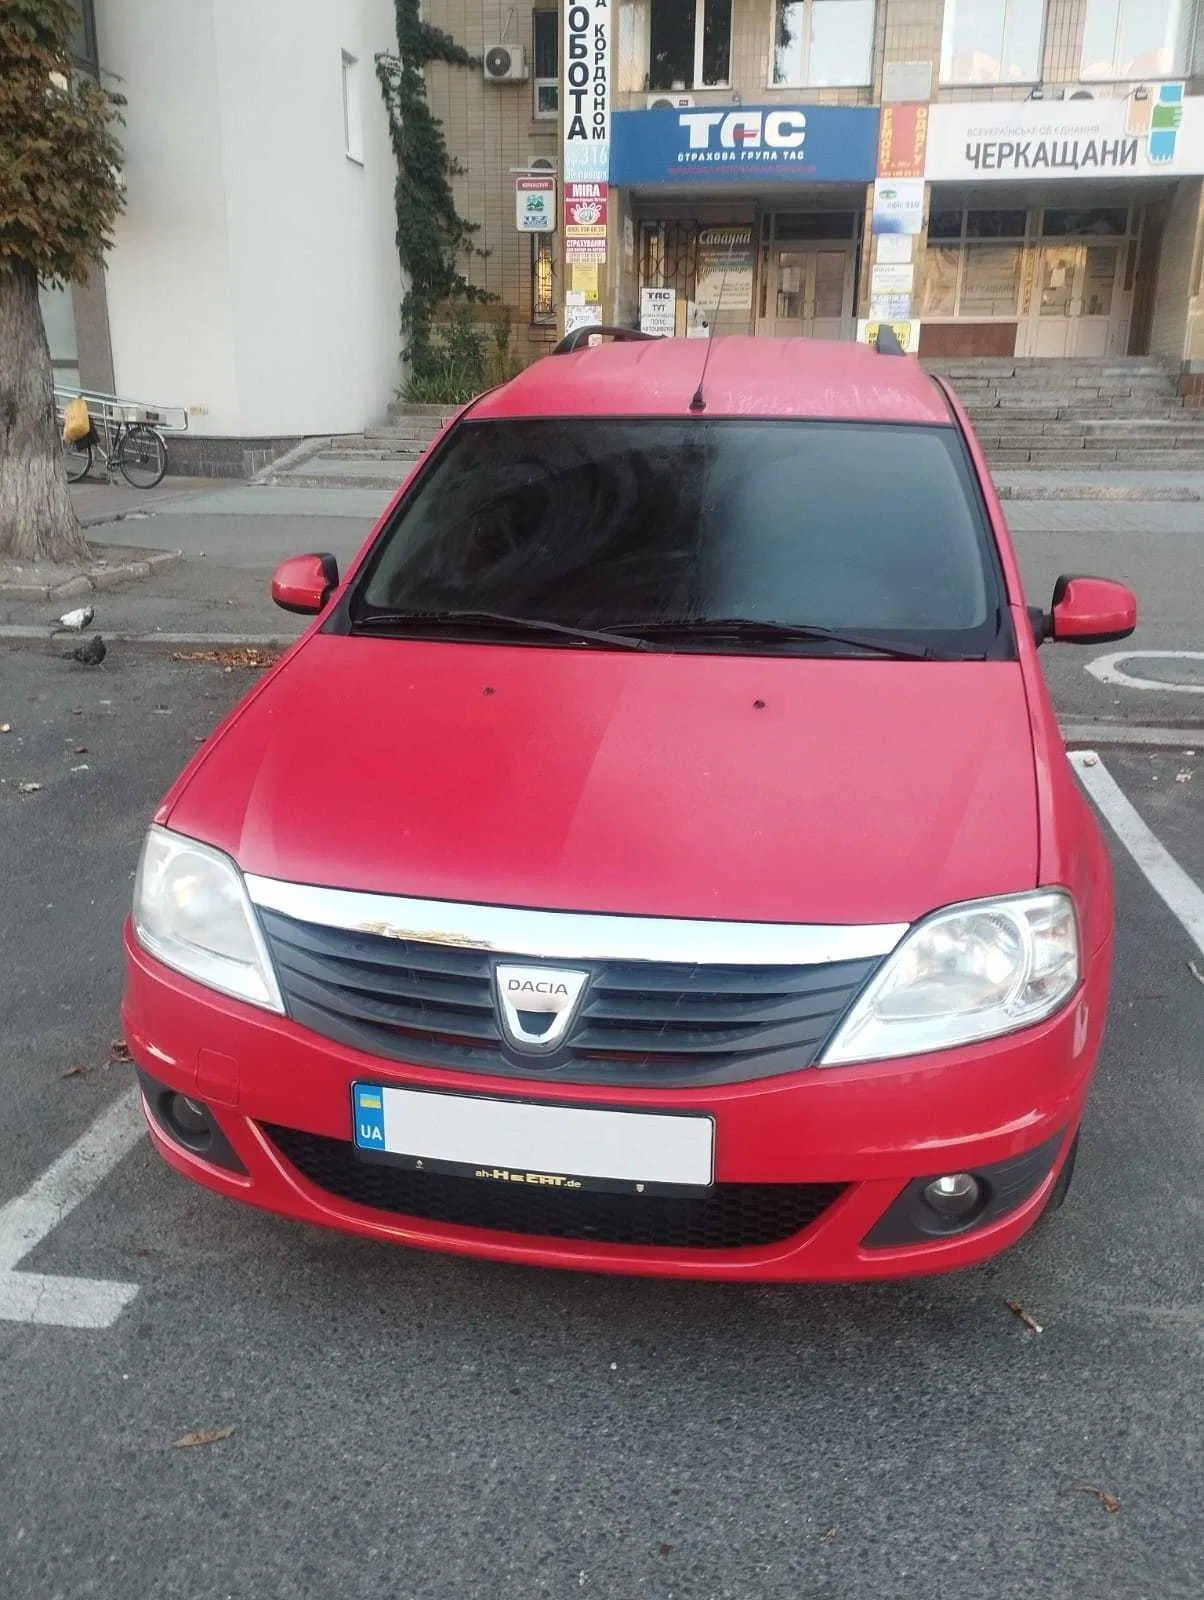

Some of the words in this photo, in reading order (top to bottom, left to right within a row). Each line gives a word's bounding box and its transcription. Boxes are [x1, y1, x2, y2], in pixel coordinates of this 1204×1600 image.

[568, 0, 590, 139] ОБОТА
[592, 24, 607, 139] КОРДОНОМ
[679, 111, 806, 149] ТАС
[677, 152, 736, 162] СТРАХОВА
[741, 151, 777, 161] ГРУПА
[783, 151, 805, 161] ТАС
[965, 139, 1138, 170] ЧЕРКАЩАНИ
[572, 183, 600, 197] MIRA
[508, 978, 568, 996] DACIA
[360, 1124, 382, 1141] UA
